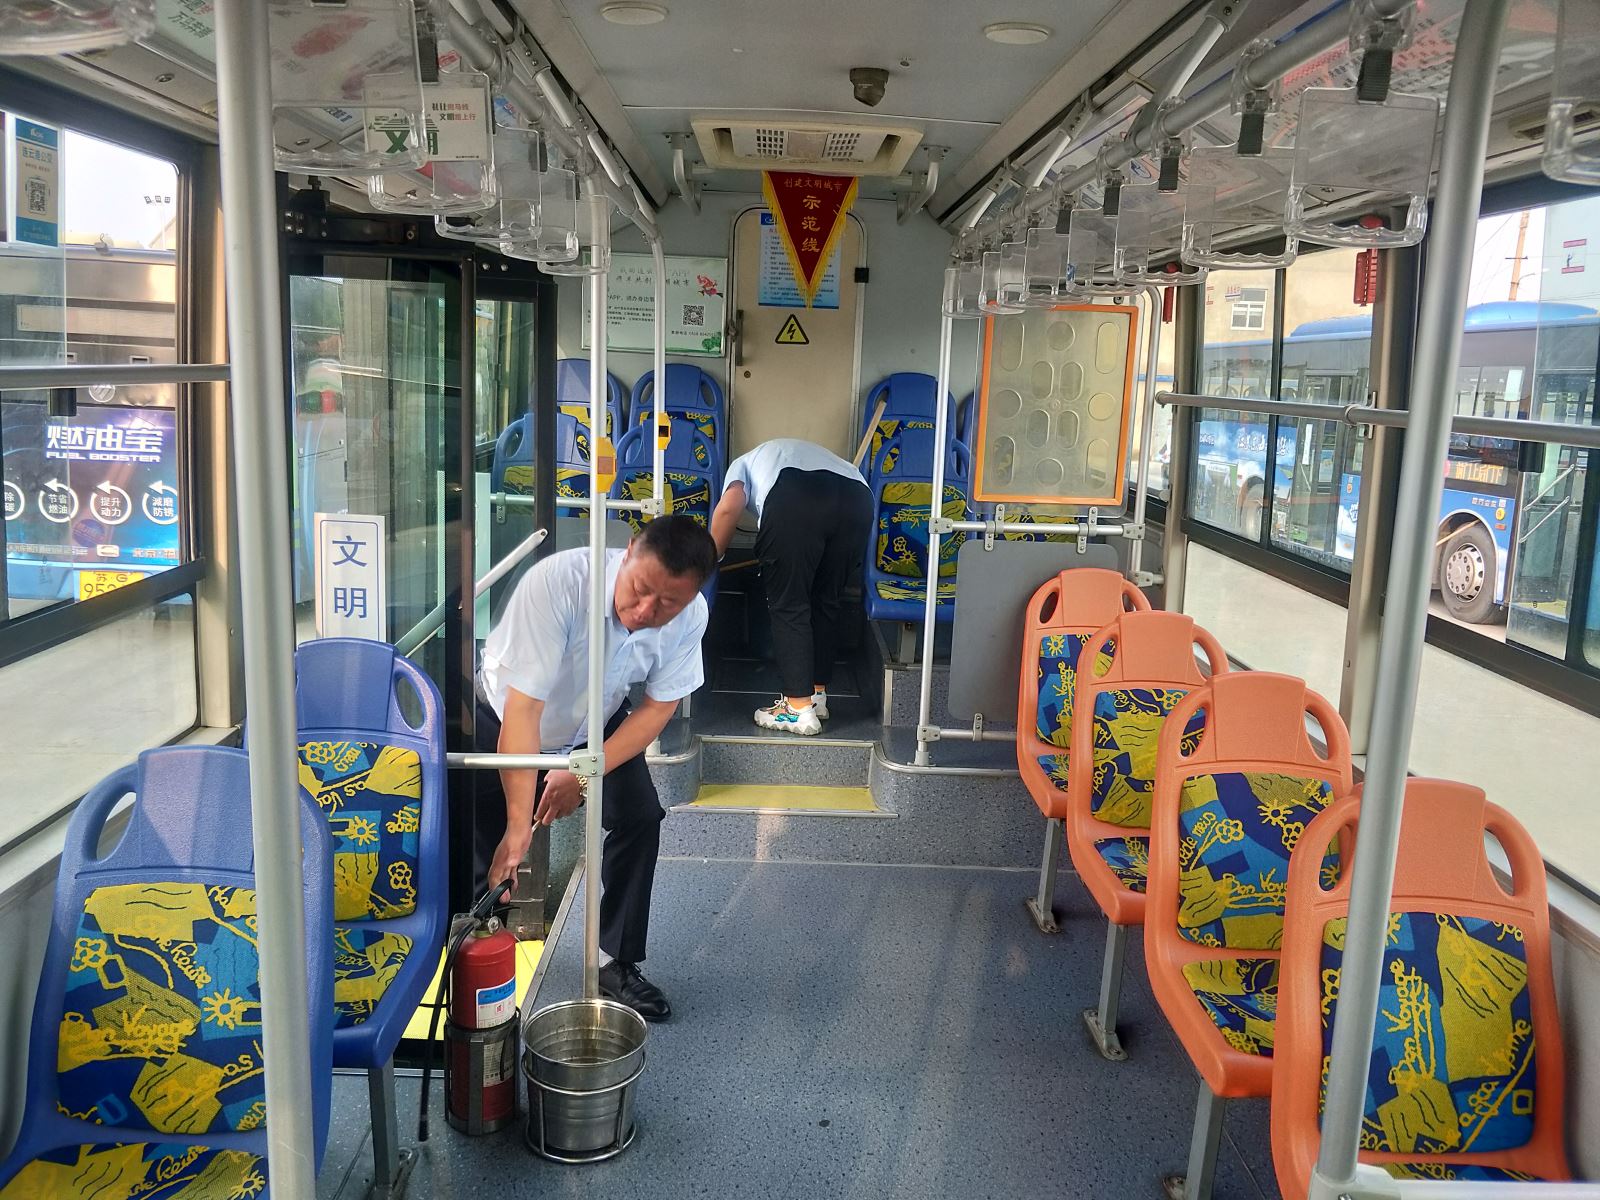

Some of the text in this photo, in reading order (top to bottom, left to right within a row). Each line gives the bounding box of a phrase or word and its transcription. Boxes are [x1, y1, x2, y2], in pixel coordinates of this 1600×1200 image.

[783, 177, 843, 193] 创建文明城市
[801, 195, 822, 253] 示范线
[46, 421, 163, 452] 燃油宝
[46, 452, 161, 462] FUEL BOOSTER
[48, 494, 68, 504] 节省
[101, 497, 121, 507] 提升
[153, 497, 174, 507] 减磨
[48, 504, 68, 514] 燃油
[101, 507, 121, 517] 动力
[153, 507, 174, 518] 防锈
[332, 535, 368, 619] 文明
